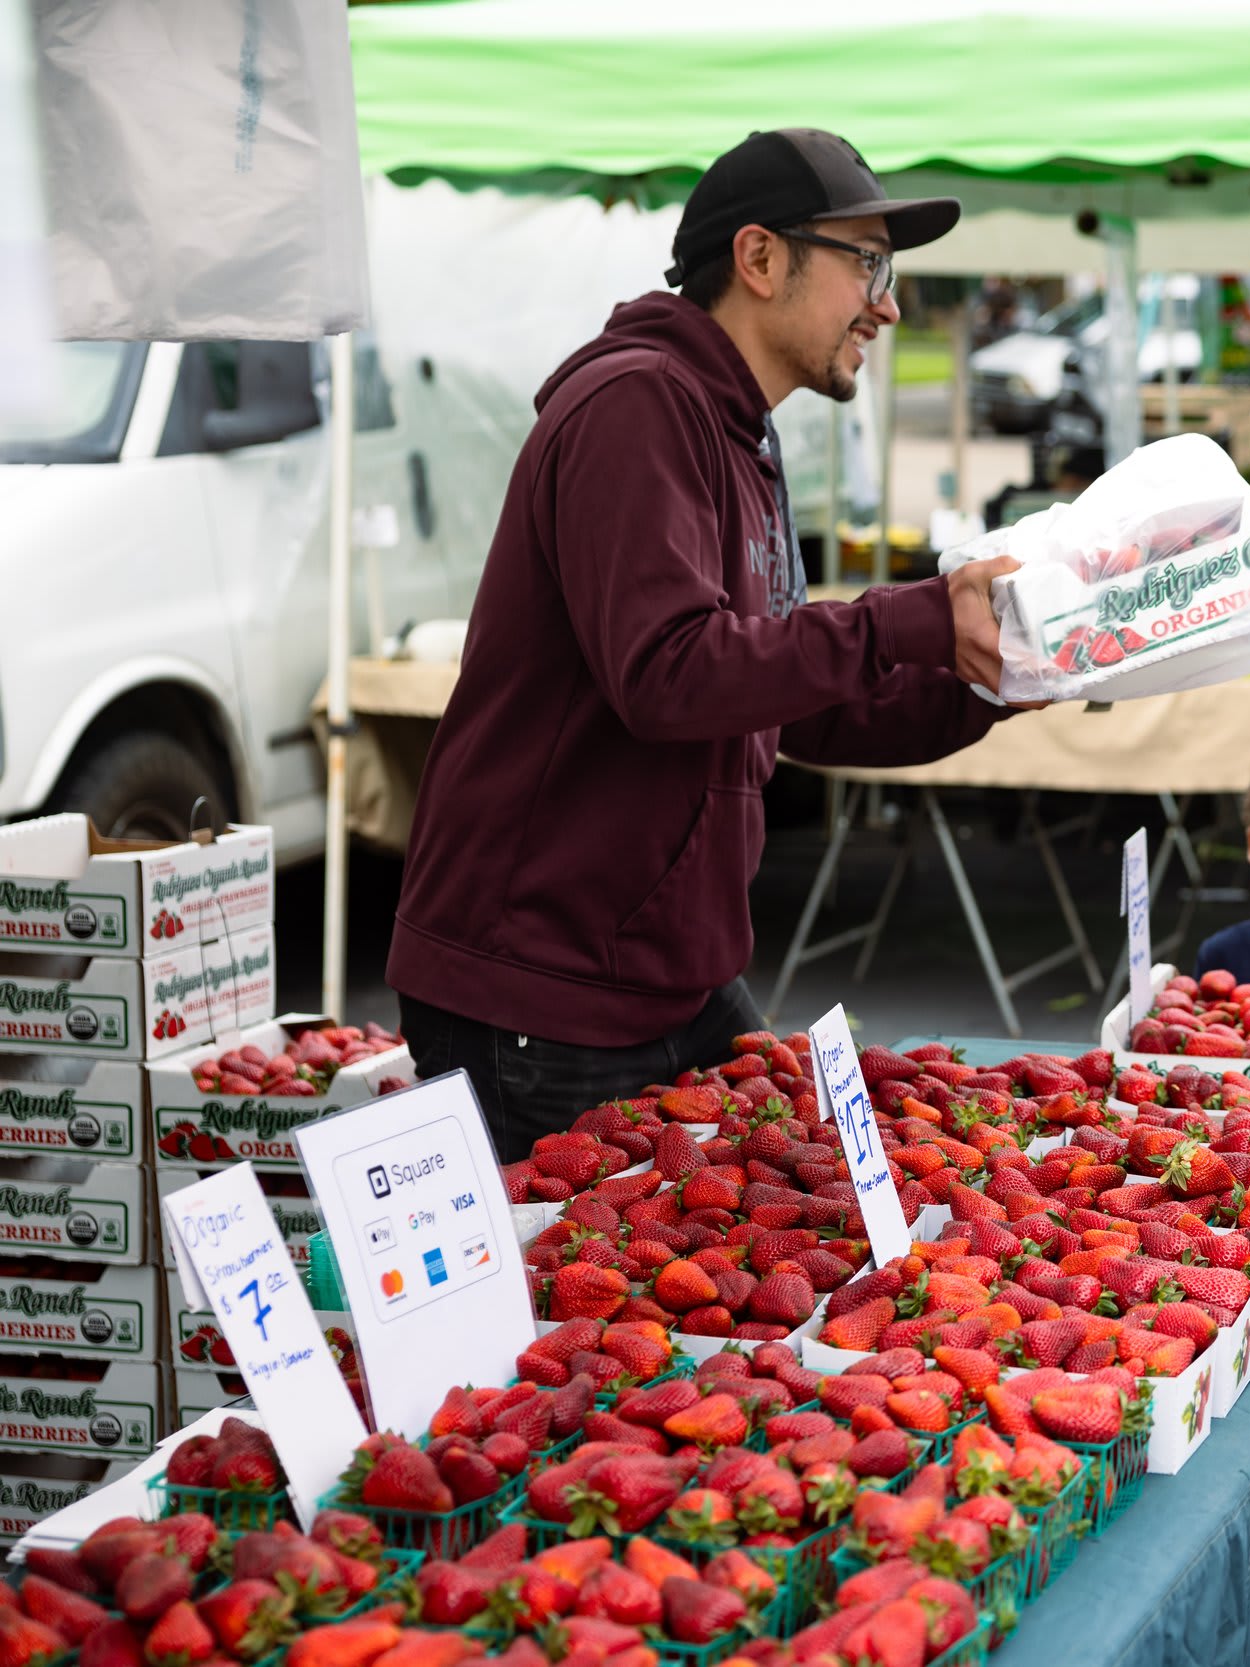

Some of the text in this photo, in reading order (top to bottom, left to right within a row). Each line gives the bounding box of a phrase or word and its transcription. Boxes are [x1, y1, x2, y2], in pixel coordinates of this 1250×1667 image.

[1095, 547, 1241, 626] Rodriguez
[0, 1087, 76, 1122] Ranch
[391, 1152, 446, 1187] Square
[418, 1210, 436, 1226] Pay
[450, 1192, 476, 1212] VISA
[183, 1204, 245, 1248] Organic
[7, 1284, 86, 1318] Ranch
[16, 1387, 97, 1419] Ranch
